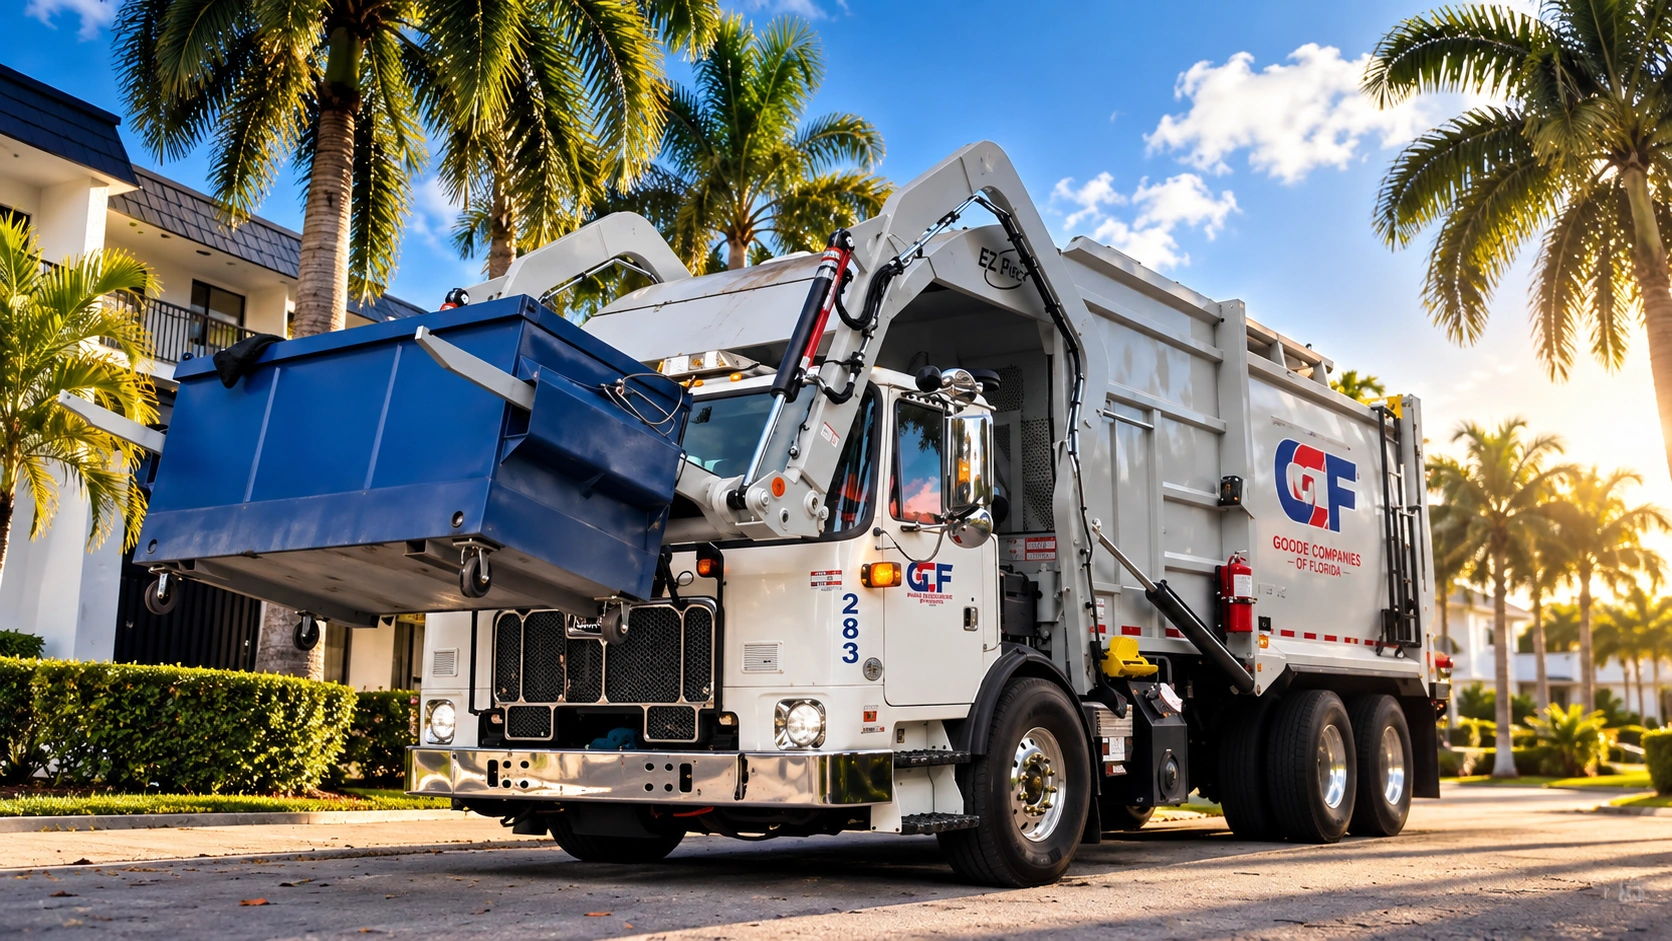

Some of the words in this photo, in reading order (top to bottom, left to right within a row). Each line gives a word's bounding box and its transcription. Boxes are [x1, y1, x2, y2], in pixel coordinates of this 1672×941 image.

[978, 247, 997, 272] EZ
[1273, 535, 1309, 556] GOODE
[1312, 544, 1361, 567] COMPANIES
[1296, 557, 1307, 571] OF
[1310, 560, 1341, 577] FLORIDA
[842, 593, 859, 664] 283
